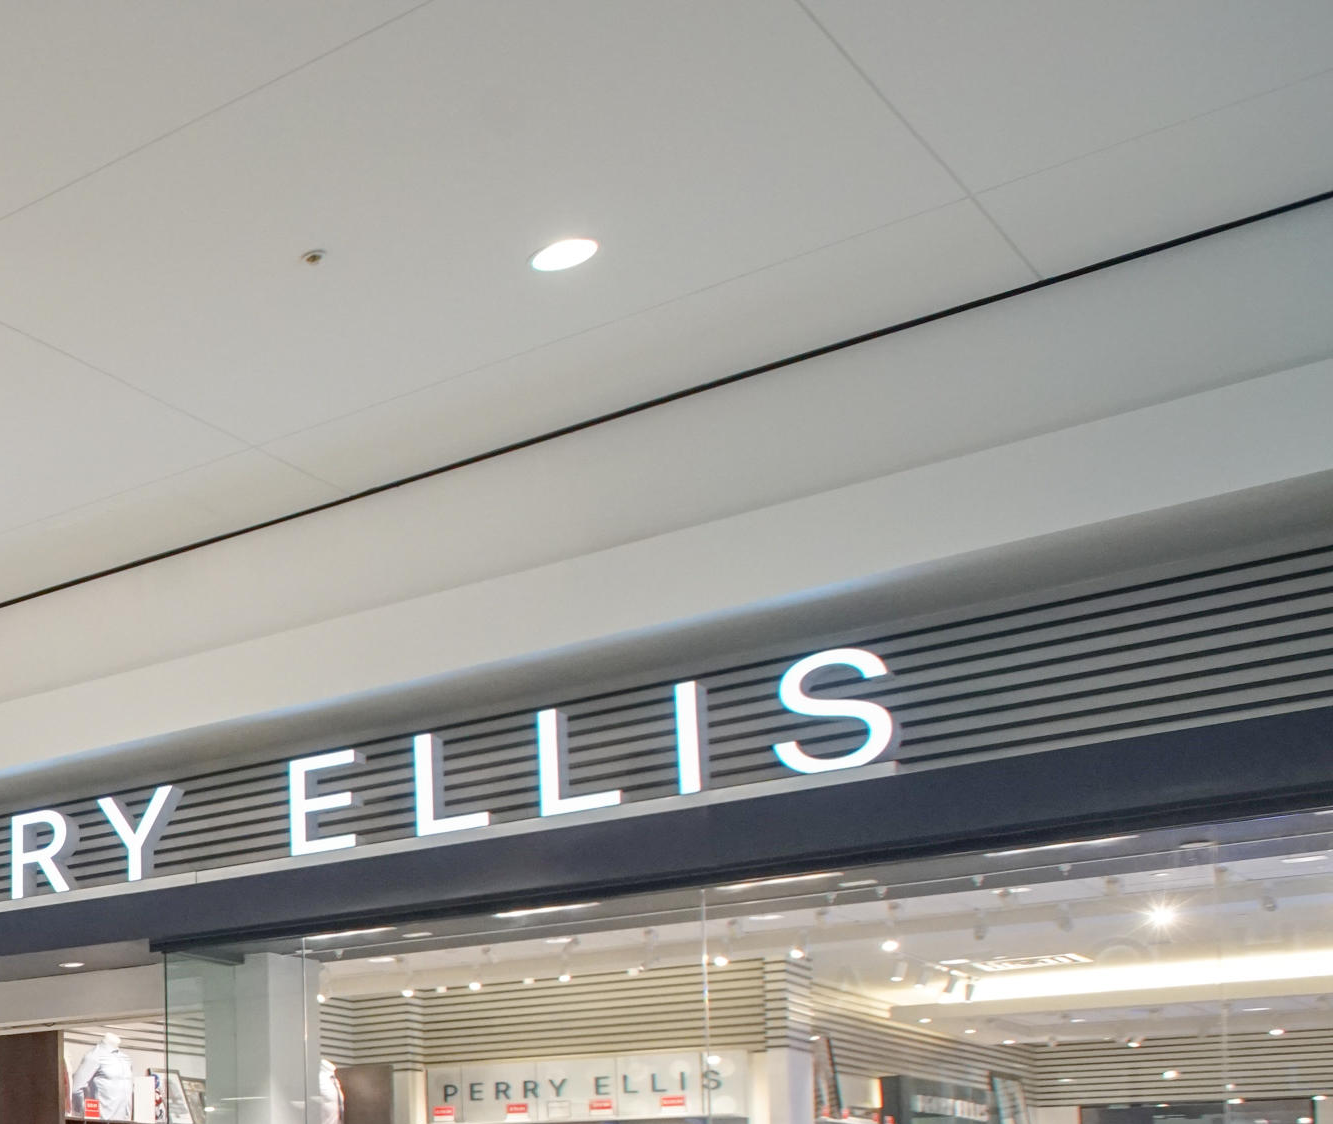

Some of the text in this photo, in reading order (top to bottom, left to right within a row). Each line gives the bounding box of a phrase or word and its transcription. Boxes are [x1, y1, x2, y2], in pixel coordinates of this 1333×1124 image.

[288, 646, 896, 858] ELLIS
[443, 1069, 723, 1102] PERRY ELLIS
